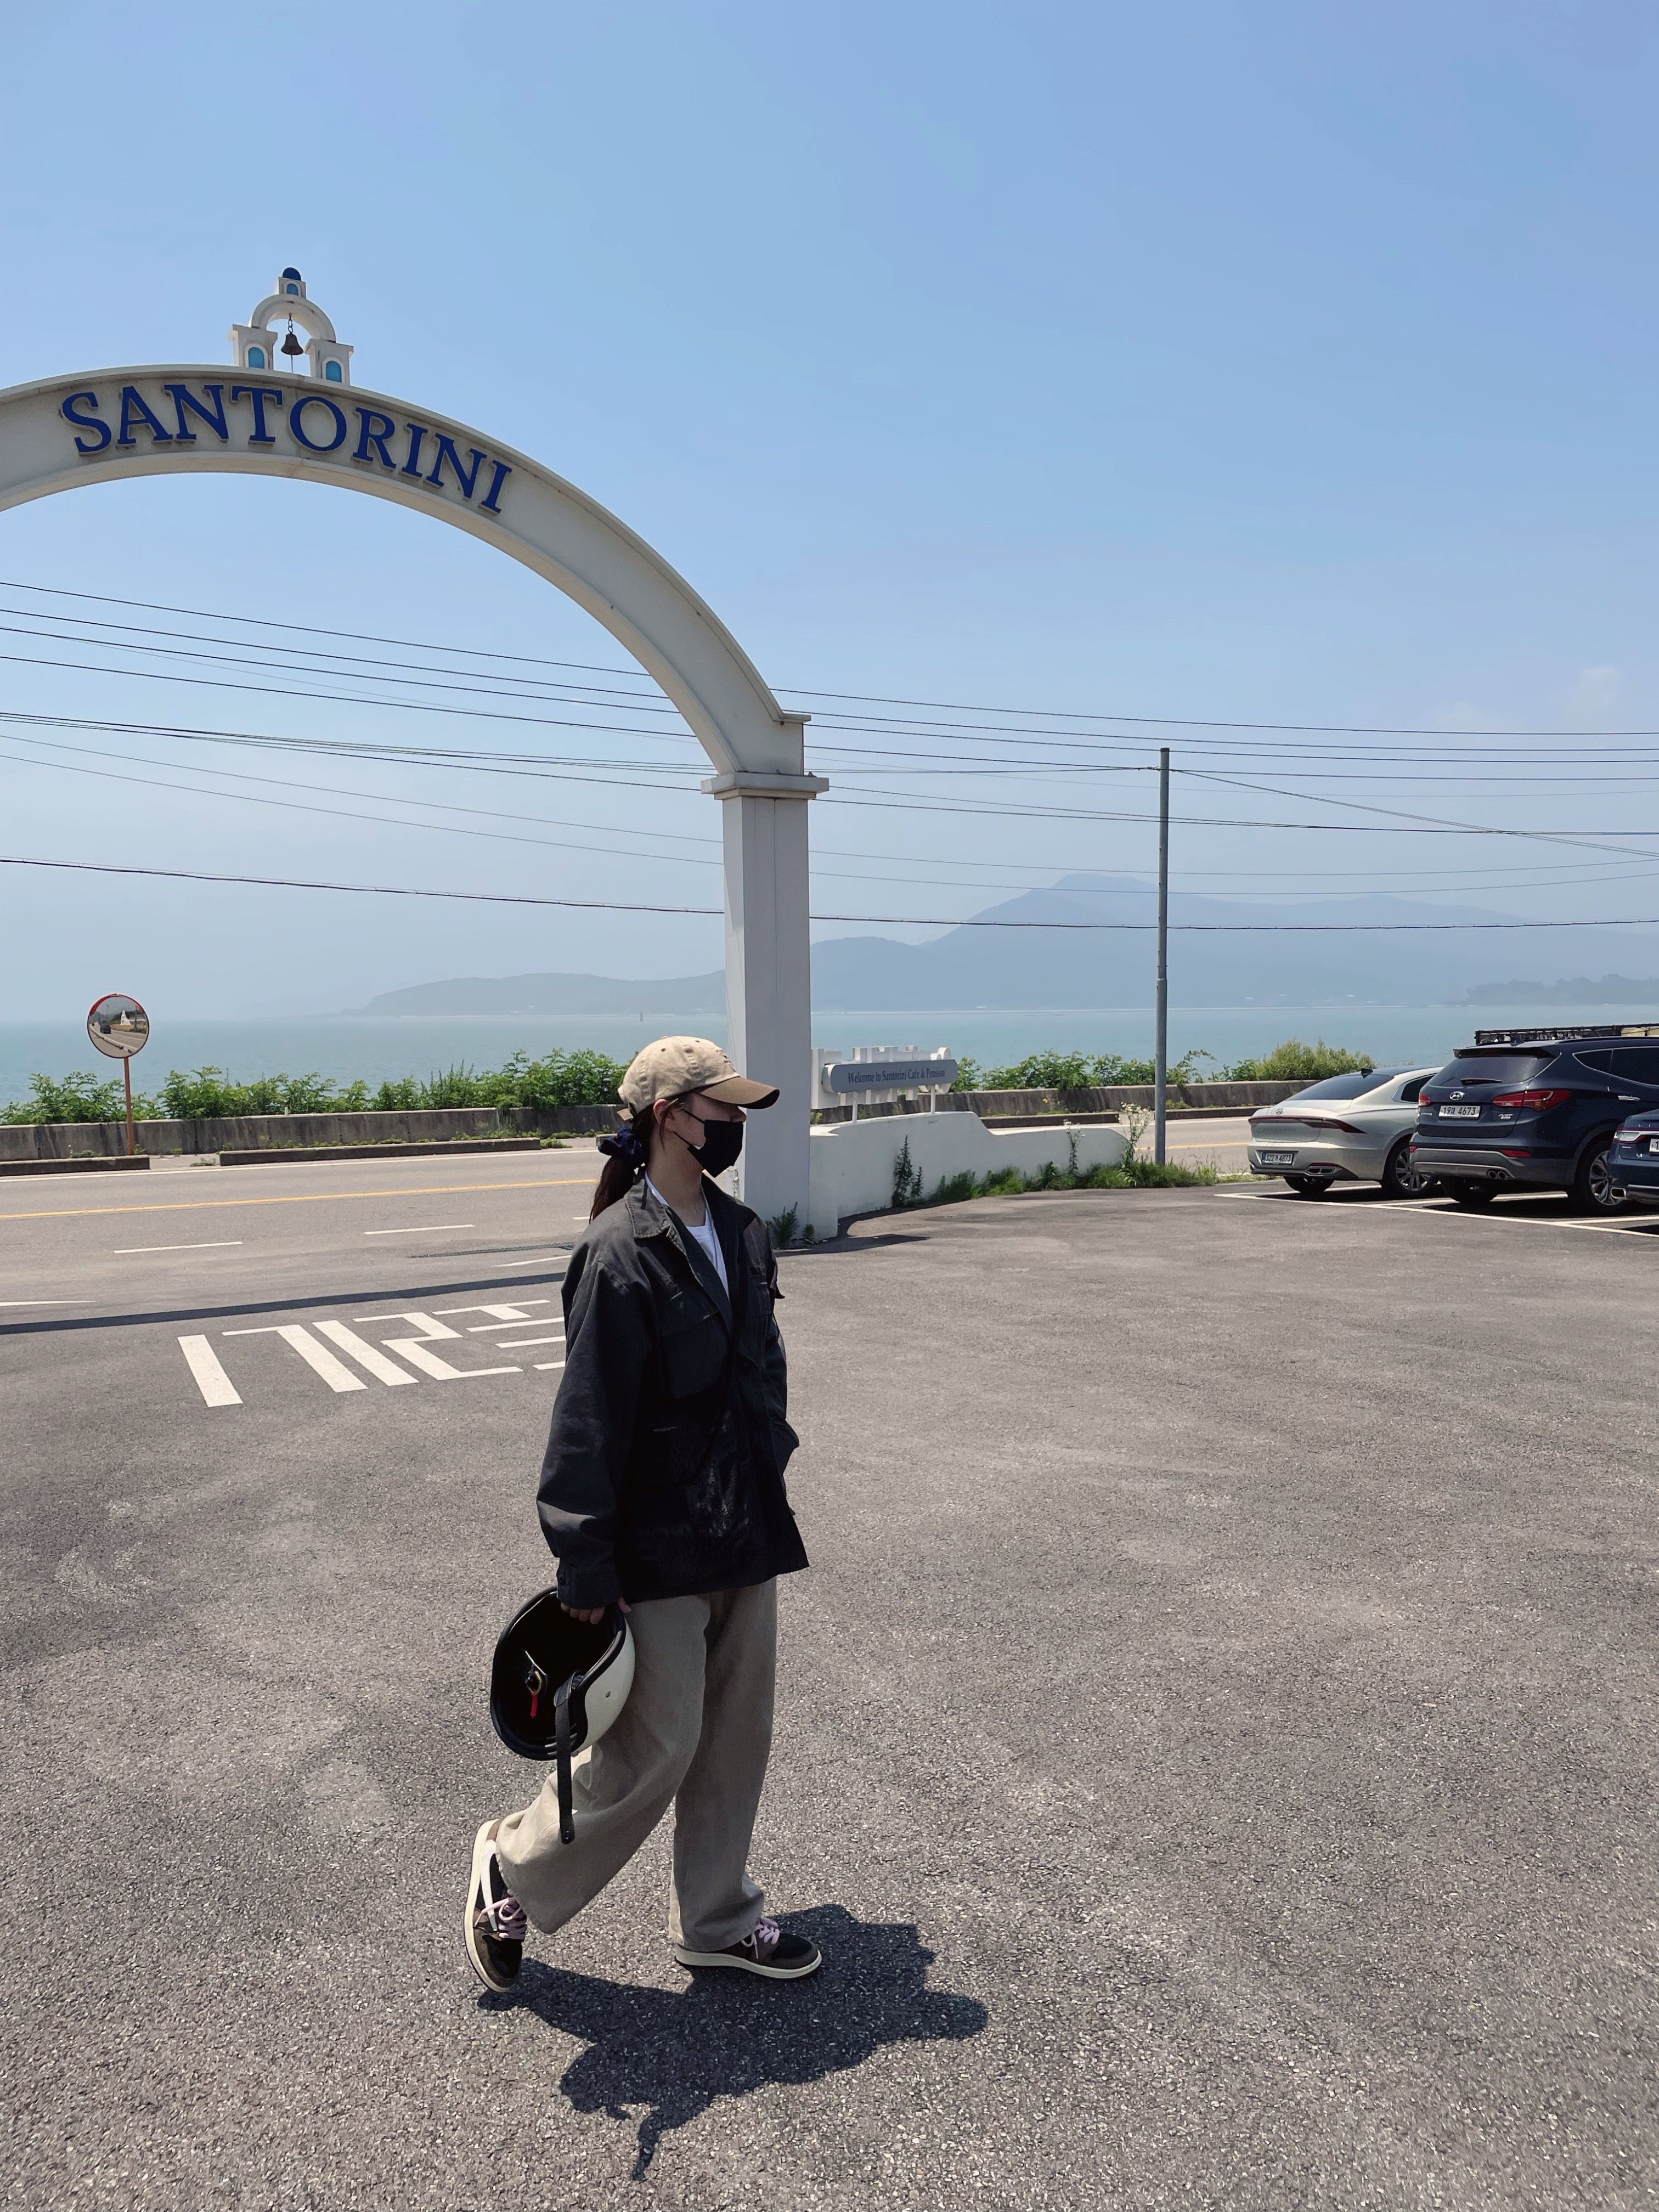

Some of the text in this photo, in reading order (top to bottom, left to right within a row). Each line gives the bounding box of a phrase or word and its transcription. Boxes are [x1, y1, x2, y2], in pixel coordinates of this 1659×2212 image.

[61, 383, 513, 514] SANTORINI
[848, 1068, 945, 1084] Welcome to Santorini Cafe & Pension
[1458, 1107, 1476, 1115] 4673
